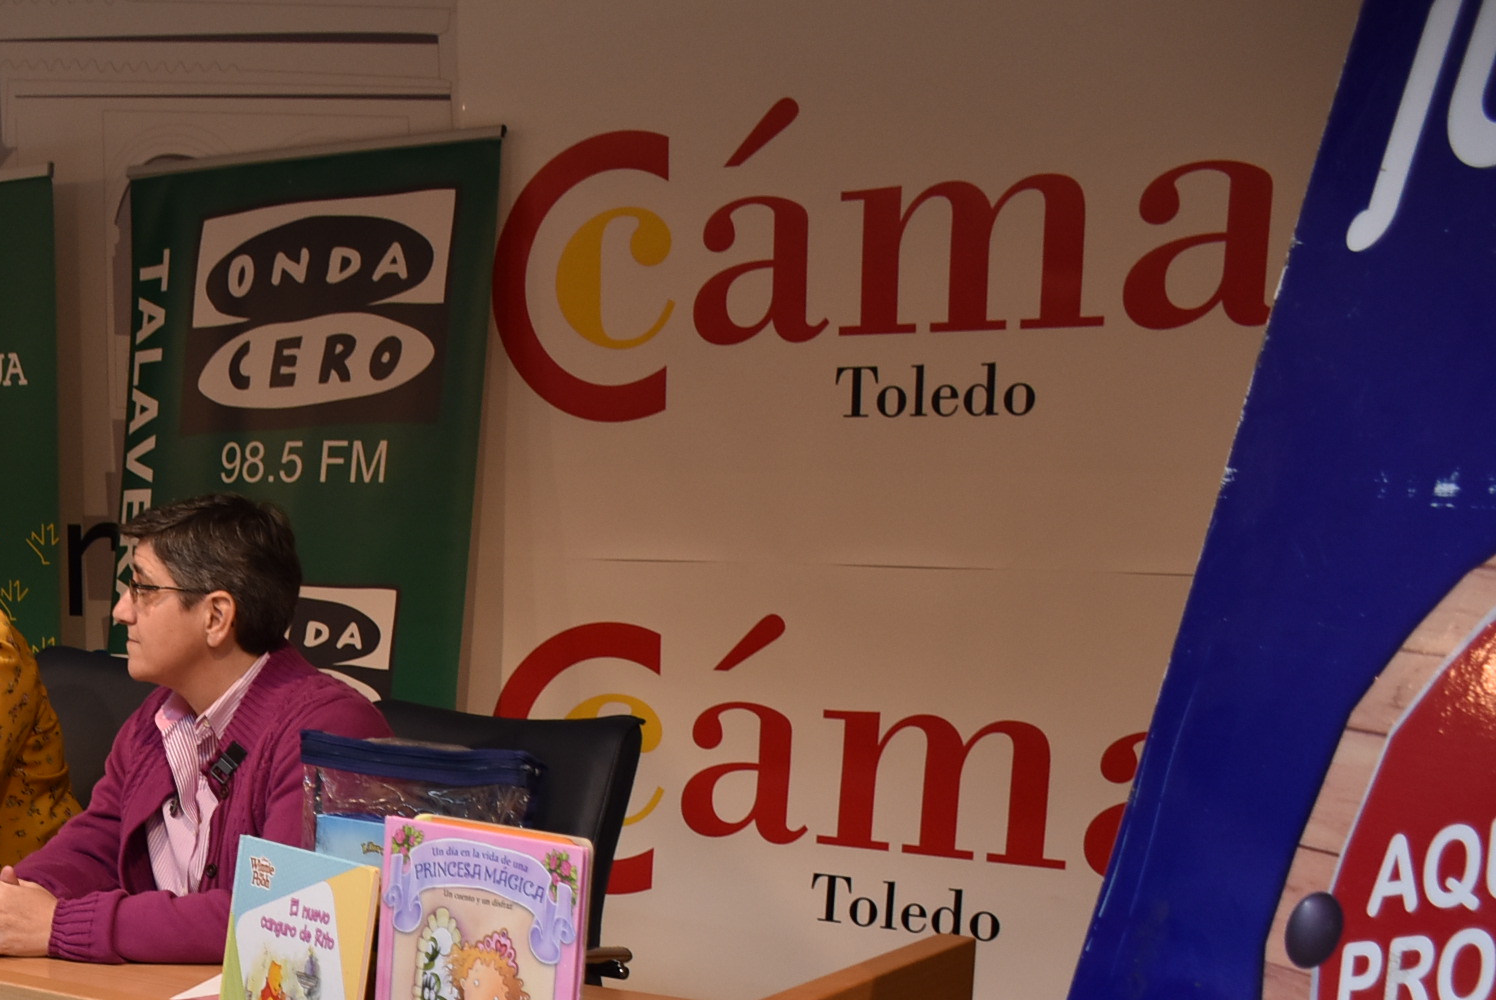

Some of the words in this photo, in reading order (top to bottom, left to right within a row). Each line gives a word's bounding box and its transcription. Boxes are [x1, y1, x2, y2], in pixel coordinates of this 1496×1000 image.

[227, 241, 408, 298] ONDA
[227, 333, 404, 390] CERO
[835, 362, 1037, 419] Toledo
[220, 439, 304, 484] 98.5
[318, 439, 389, 484] FM
[414, 861, 482, 880] PRINCESA
[484, 867, 546, 903] MÁGICA
[432, 847, 444, 857] Un
[460, 849, 470, 857] en
[472, 848, 480, 859] la
[481, 851, 499, 863] vida
[500, 854, 512, 867] de
[512, 861, 529, 873] una
[260, 916, 297, 938] canguro
[299, 924, 312, 943] de
[302, 905, 330, 925] nuevo
[811, 872, 1002, 942] Toledo
